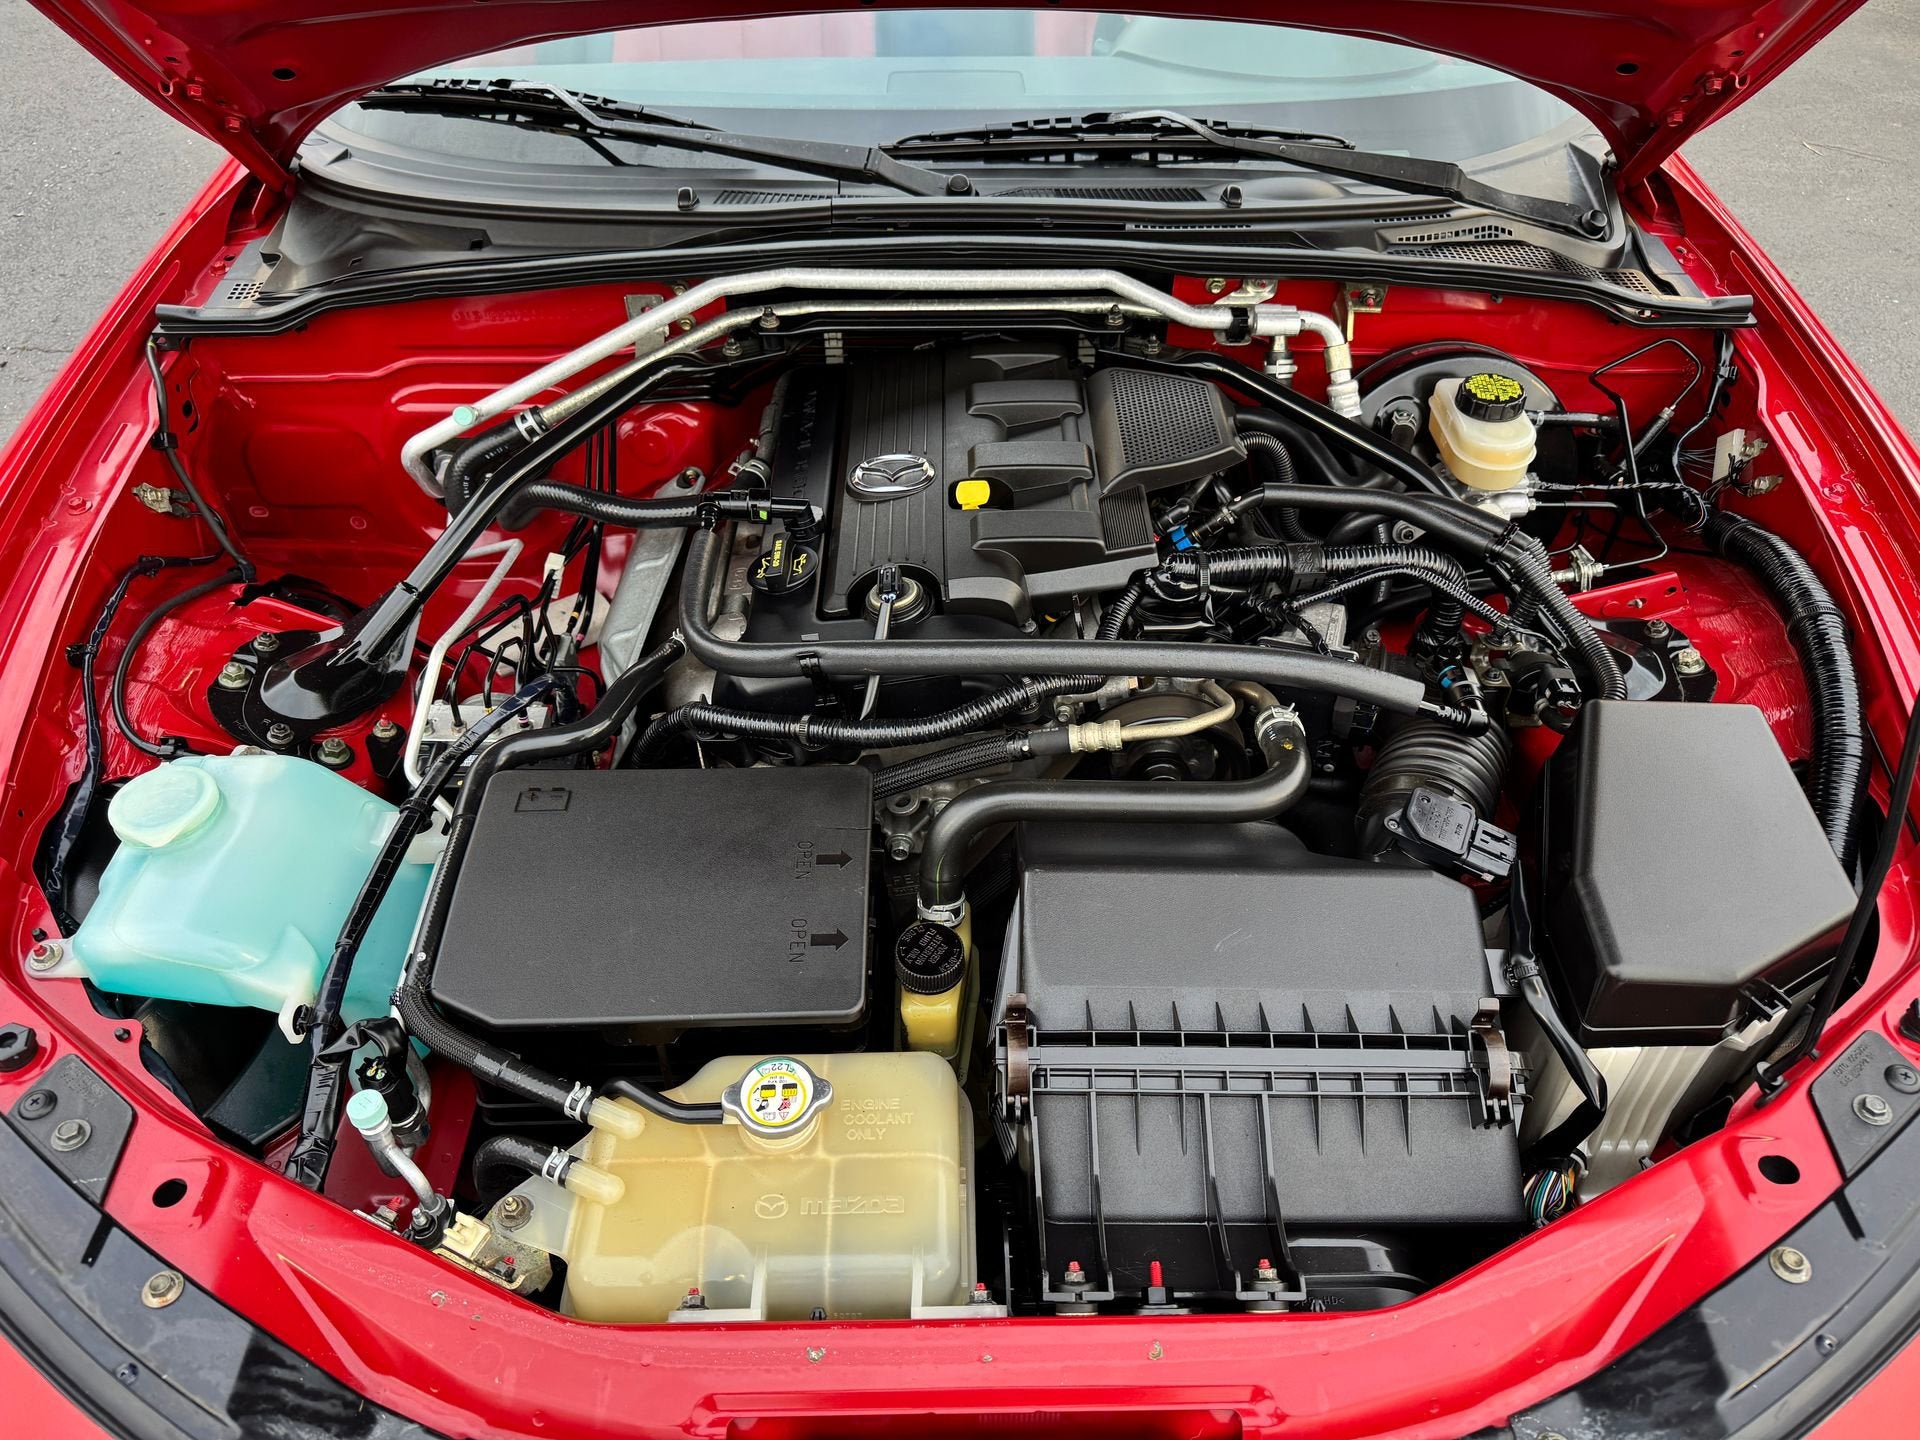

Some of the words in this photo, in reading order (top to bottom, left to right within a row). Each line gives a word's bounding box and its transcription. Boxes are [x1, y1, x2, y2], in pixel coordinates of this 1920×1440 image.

[795, 841, 813, 879] OPEN
[788, 918, 807, 962] OPEN
[901, 925, 926, 942] CLOSE
[919, 928, 937, 946] FLUID
[905, 948, 921, 964] ONLY
[914, 934, 943, 966] STEERING
[928, 943, 948, 964] POWER
[841, 1098, 901, 1110] ENGINE
[843, 1112, 913, 1125] COOLANT
[846, 1128, 886, 1140] ONLY
